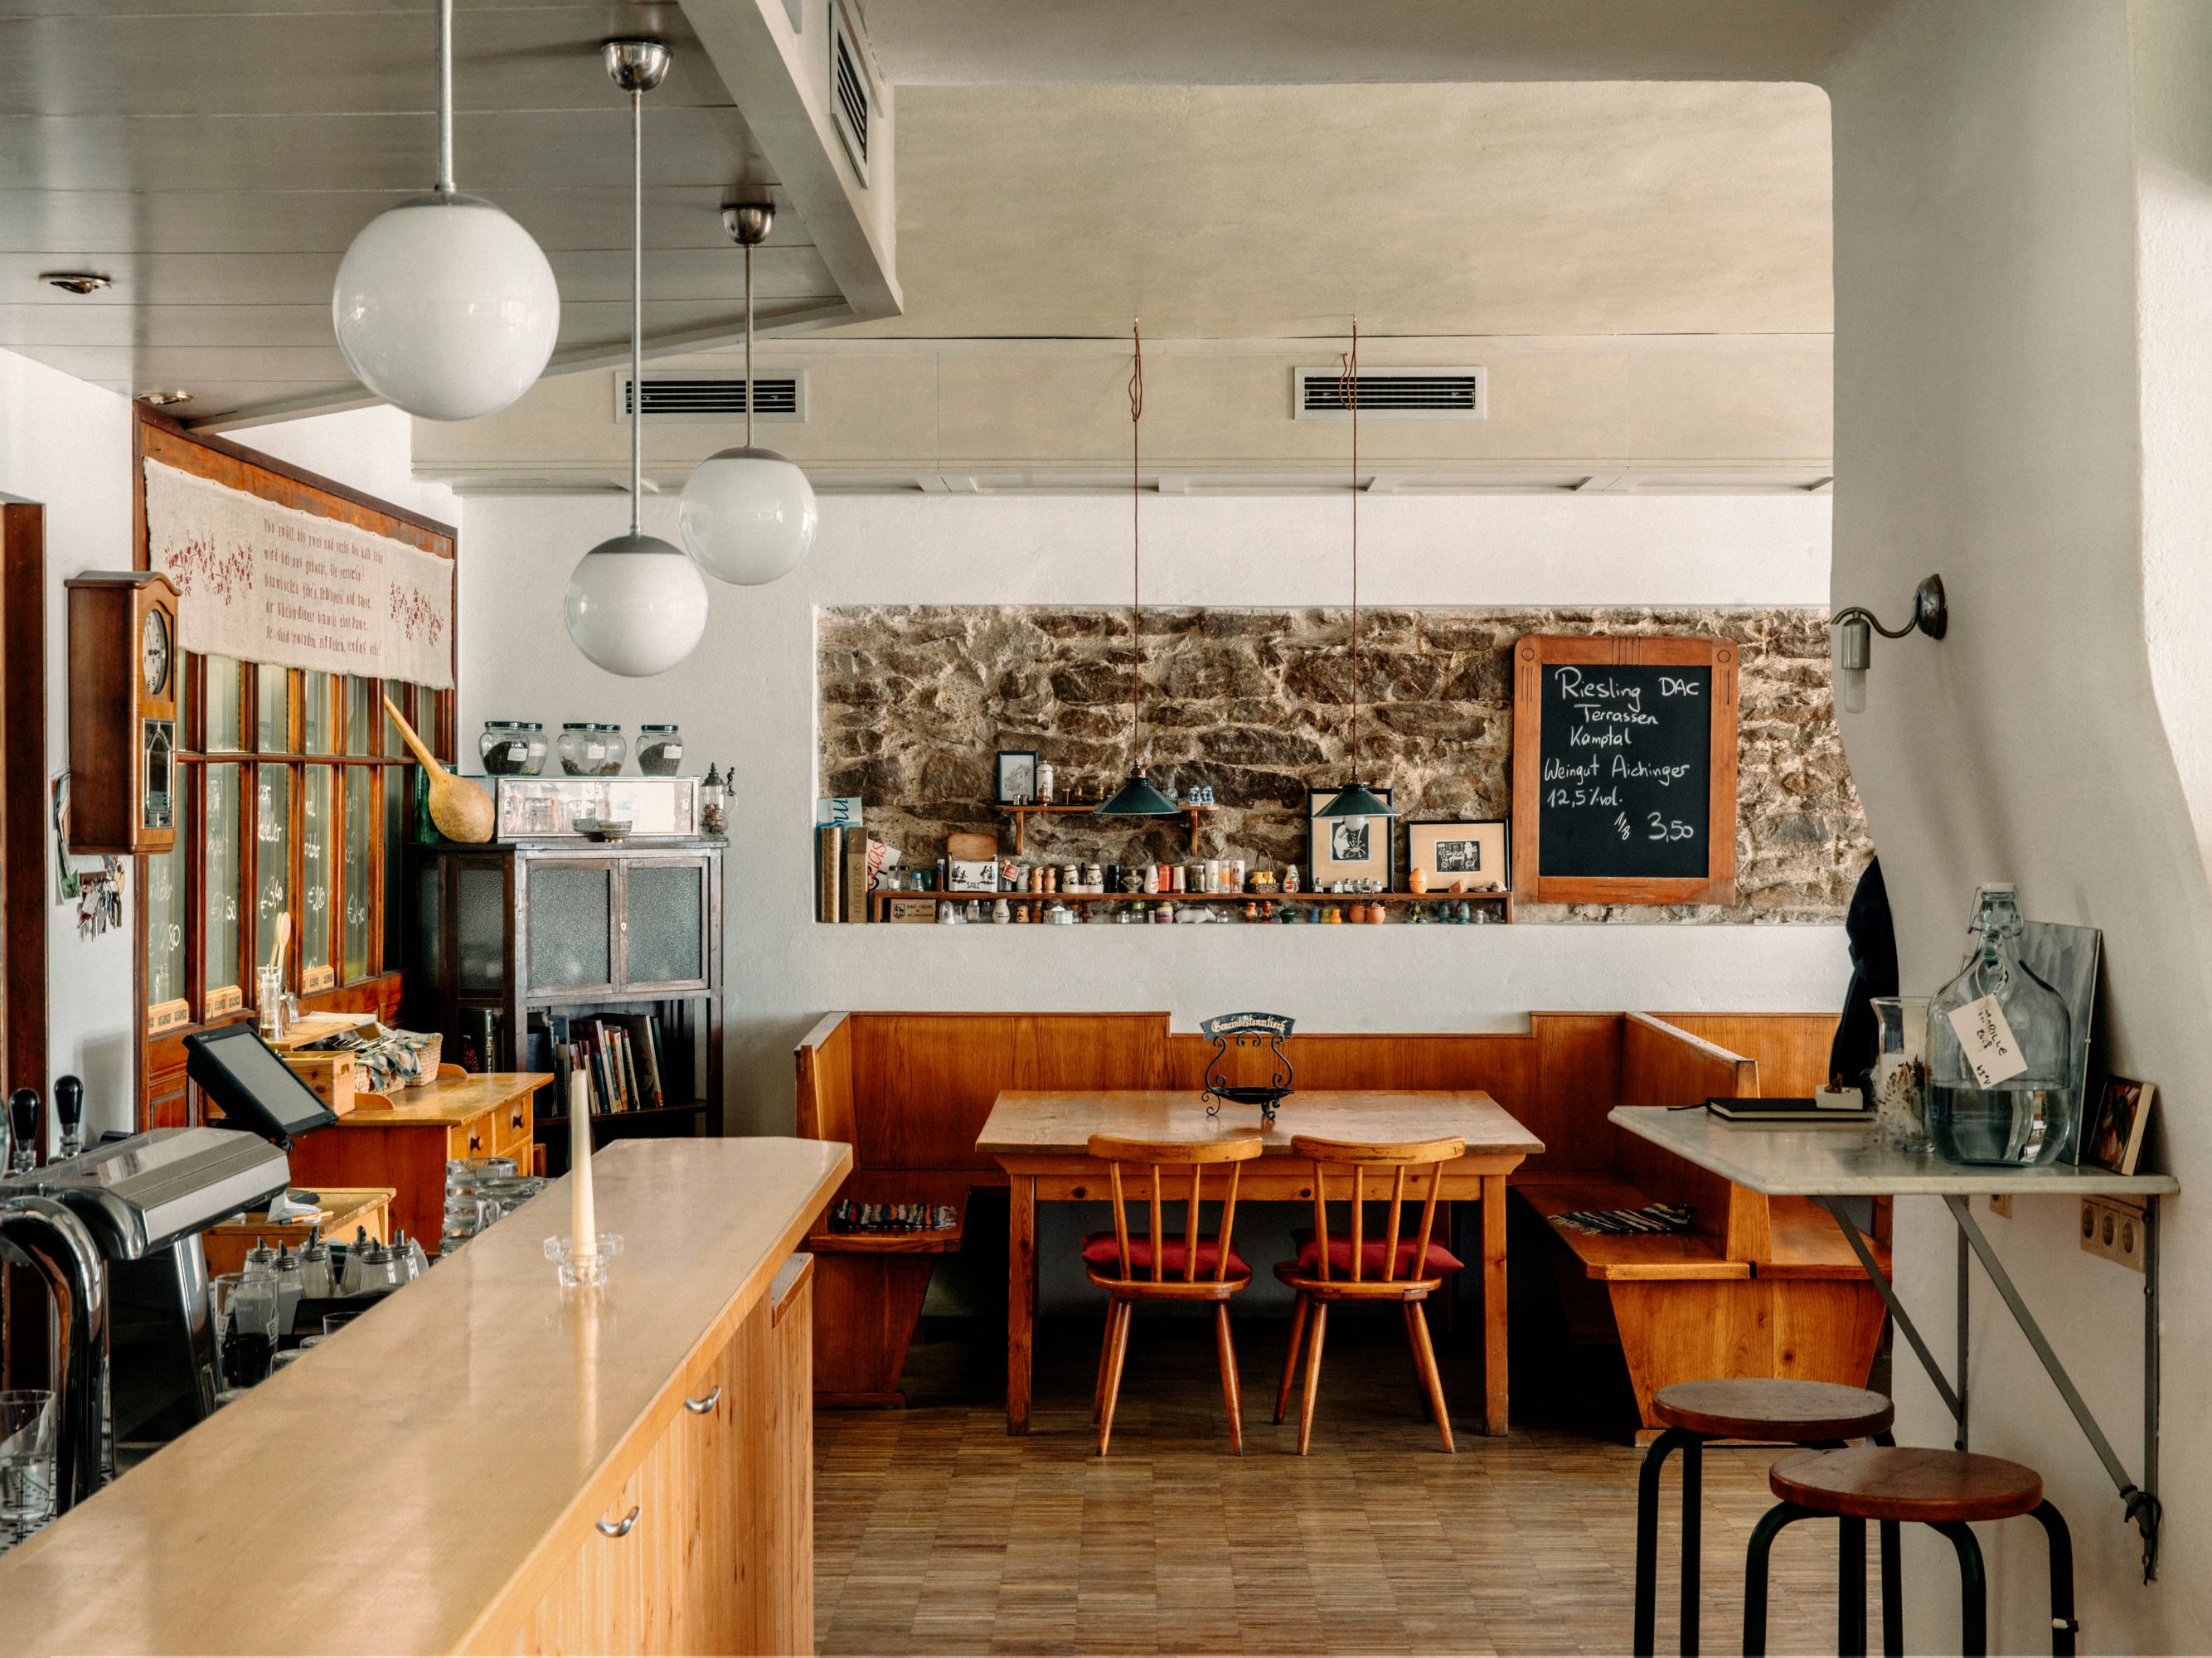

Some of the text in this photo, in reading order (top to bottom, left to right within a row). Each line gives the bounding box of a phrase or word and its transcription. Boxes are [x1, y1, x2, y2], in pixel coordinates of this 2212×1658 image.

[264, 518, 274, 534] Von
[309, 535, 322, 548] zwei
[1555, 667, 1700, 712] Riesling DAC
[1574, 704, 1659, 725] Terrassen
[1569, 725, 1632, 749] Kamptal
[1544, 754, 1691, 787] Weingut Aichinger
[1614, 812, 1632, 841] 1/8
[1647, 812, 1695, 843] 3,50
[966, 881, 981, 890] SALZ
